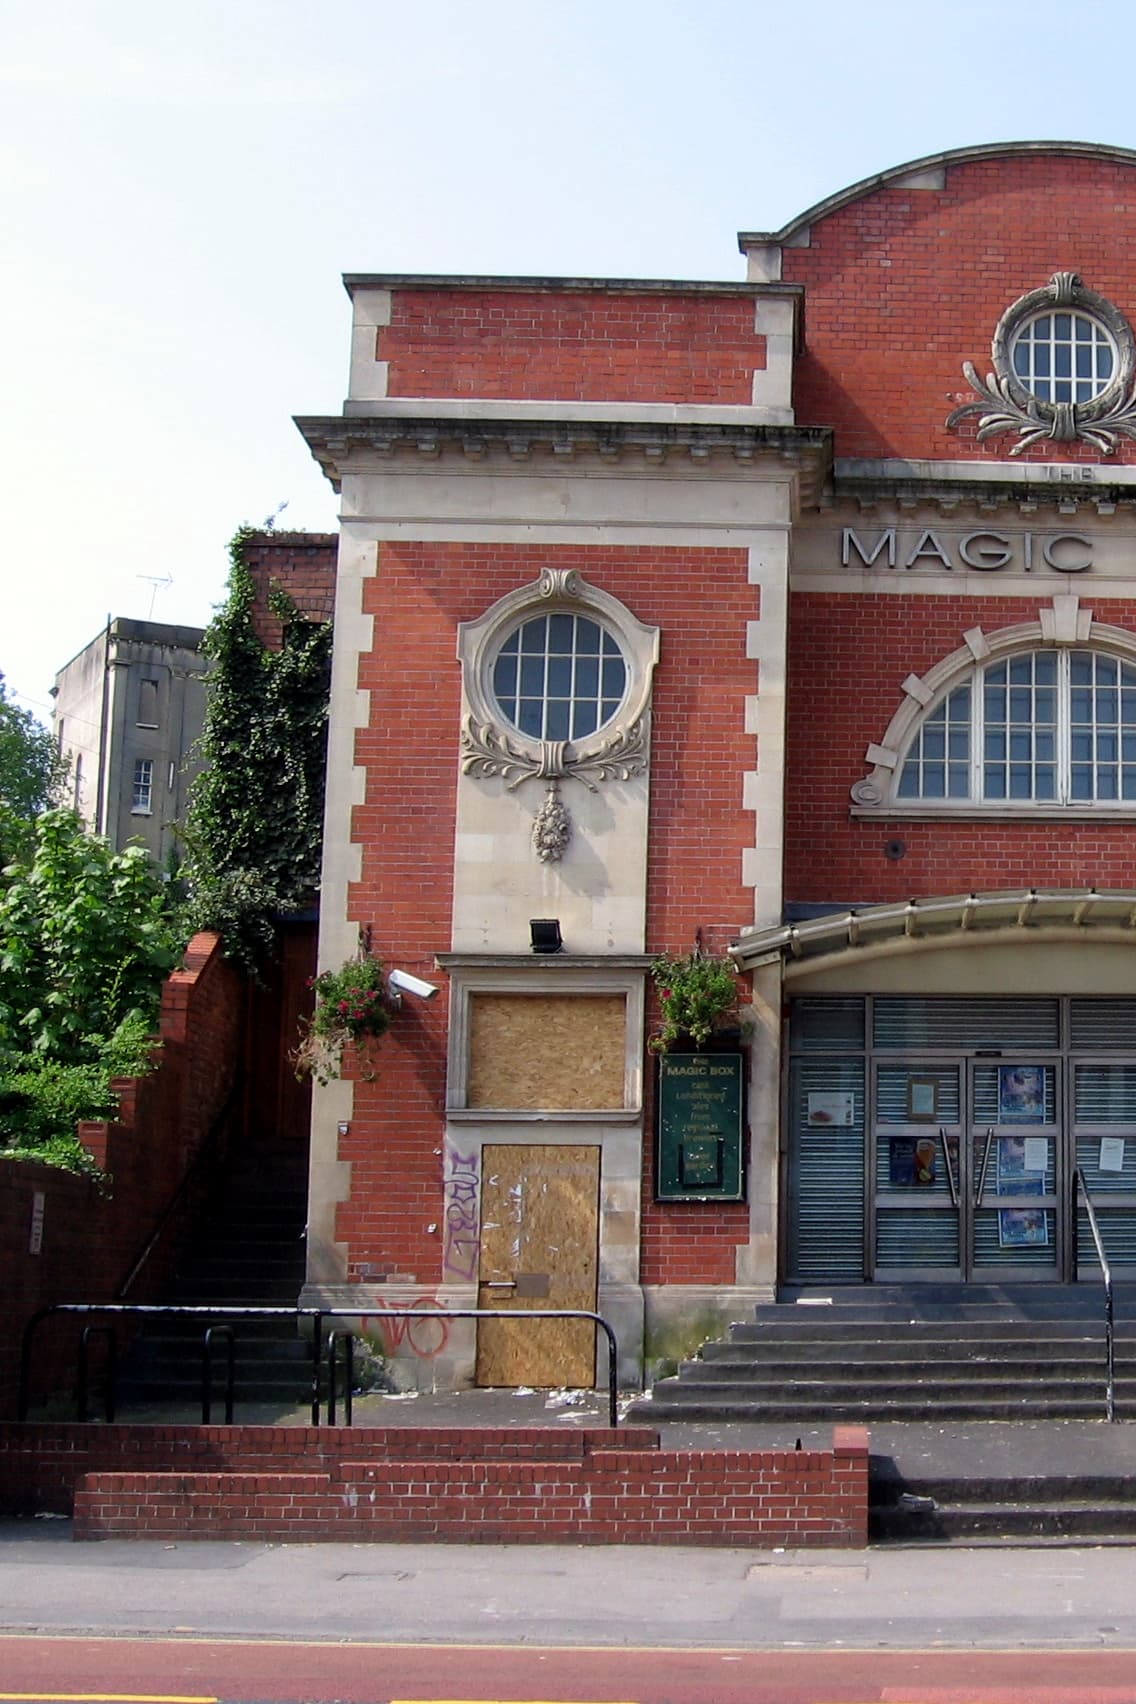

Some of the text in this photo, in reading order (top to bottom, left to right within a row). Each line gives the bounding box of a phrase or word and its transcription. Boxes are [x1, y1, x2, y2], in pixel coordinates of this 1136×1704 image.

[1042, 465, 1093, 482] THE
[841, 526, 1094, 573] MAGIC
[667, 1066, 735, 1076] MAGIC BOX
